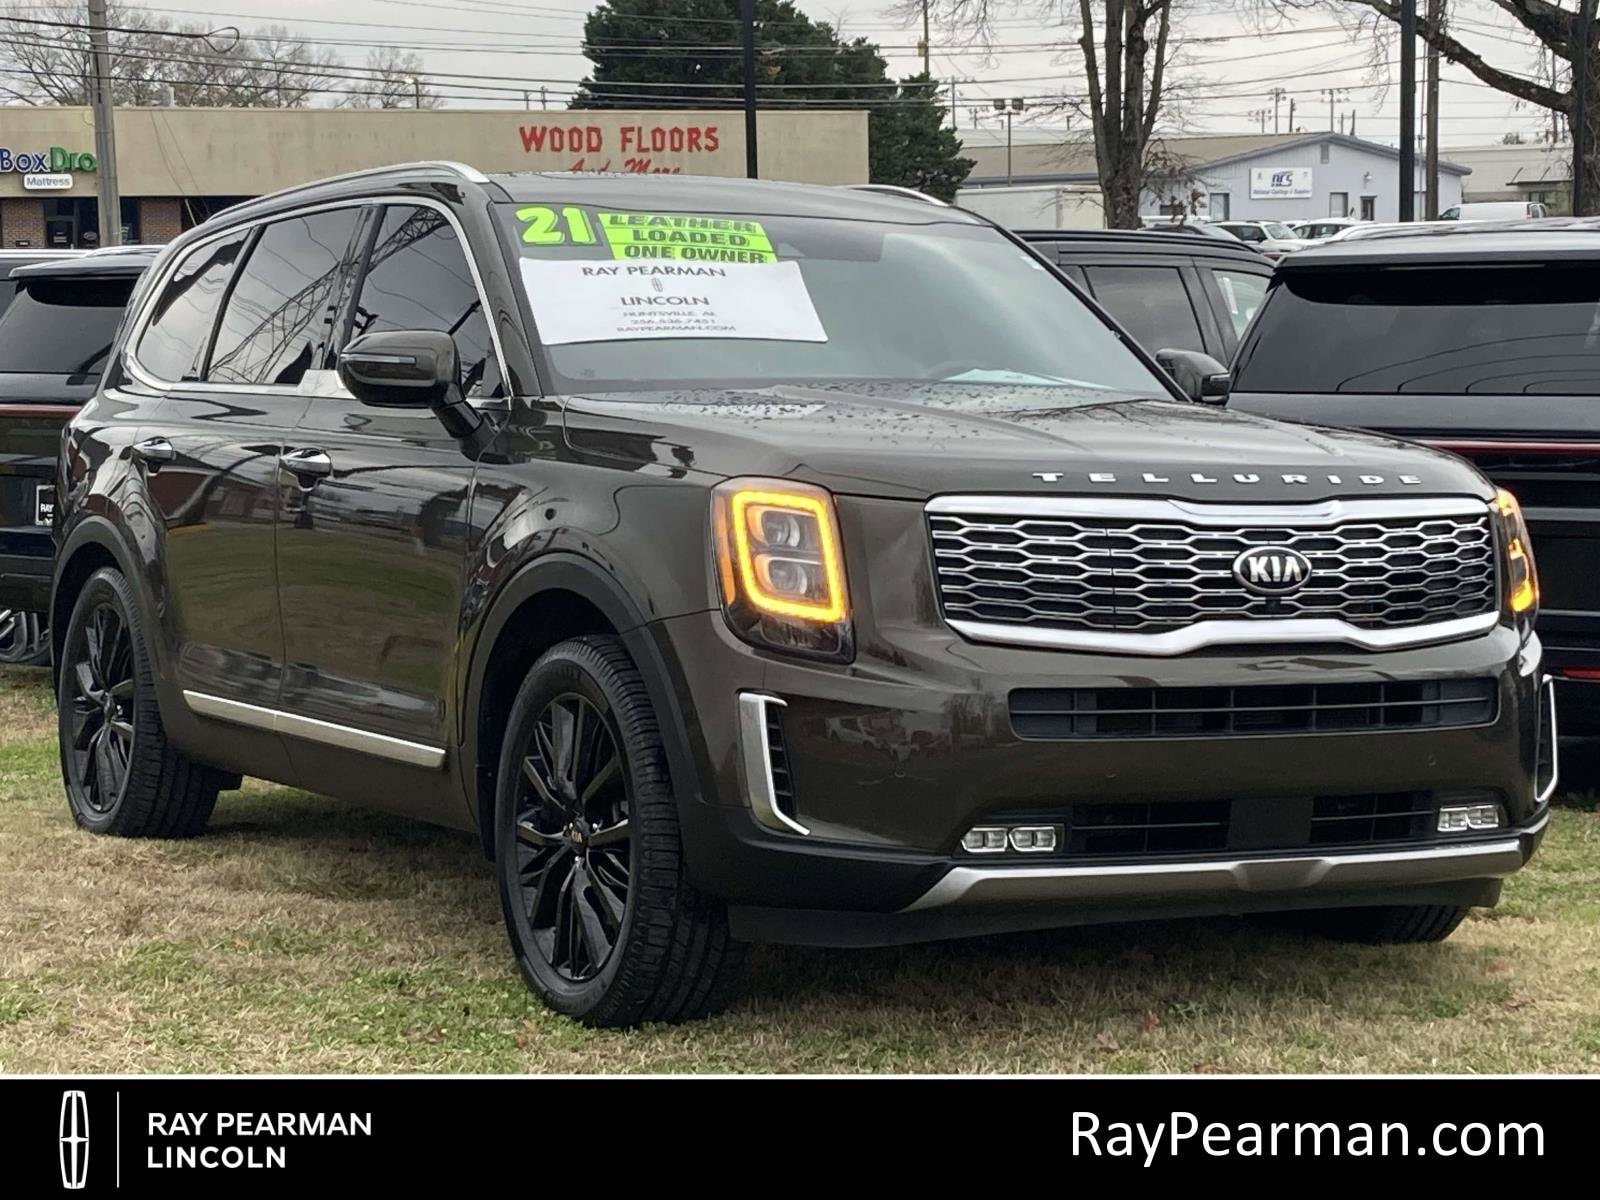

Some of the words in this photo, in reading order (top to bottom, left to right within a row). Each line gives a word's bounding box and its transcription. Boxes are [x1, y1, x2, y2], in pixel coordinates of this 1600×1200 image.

[519, 126, 603, 153] WOOD
[620, 126, 719, 153] FLOORS
[0, 146, 97, 173] BoxDro
[26, 177, 71, 187] Mattress
[515, 206, 596, 245] 21
[609, 214, 757, 233] LEATHER
[632, 229, 750, 247] LOADED
[624, 245, 675, 260] ONE
[680, 247, 767, 264] OWNER
[582, 266, 619, 277] RAY
[627, 266, 727, 278] PEARMAN
[620, 296, 710, 306] LINCOLN
[1032, 471, 1422, 486] TELLURIDE
[1248, 555, 1302, 583] KIA
